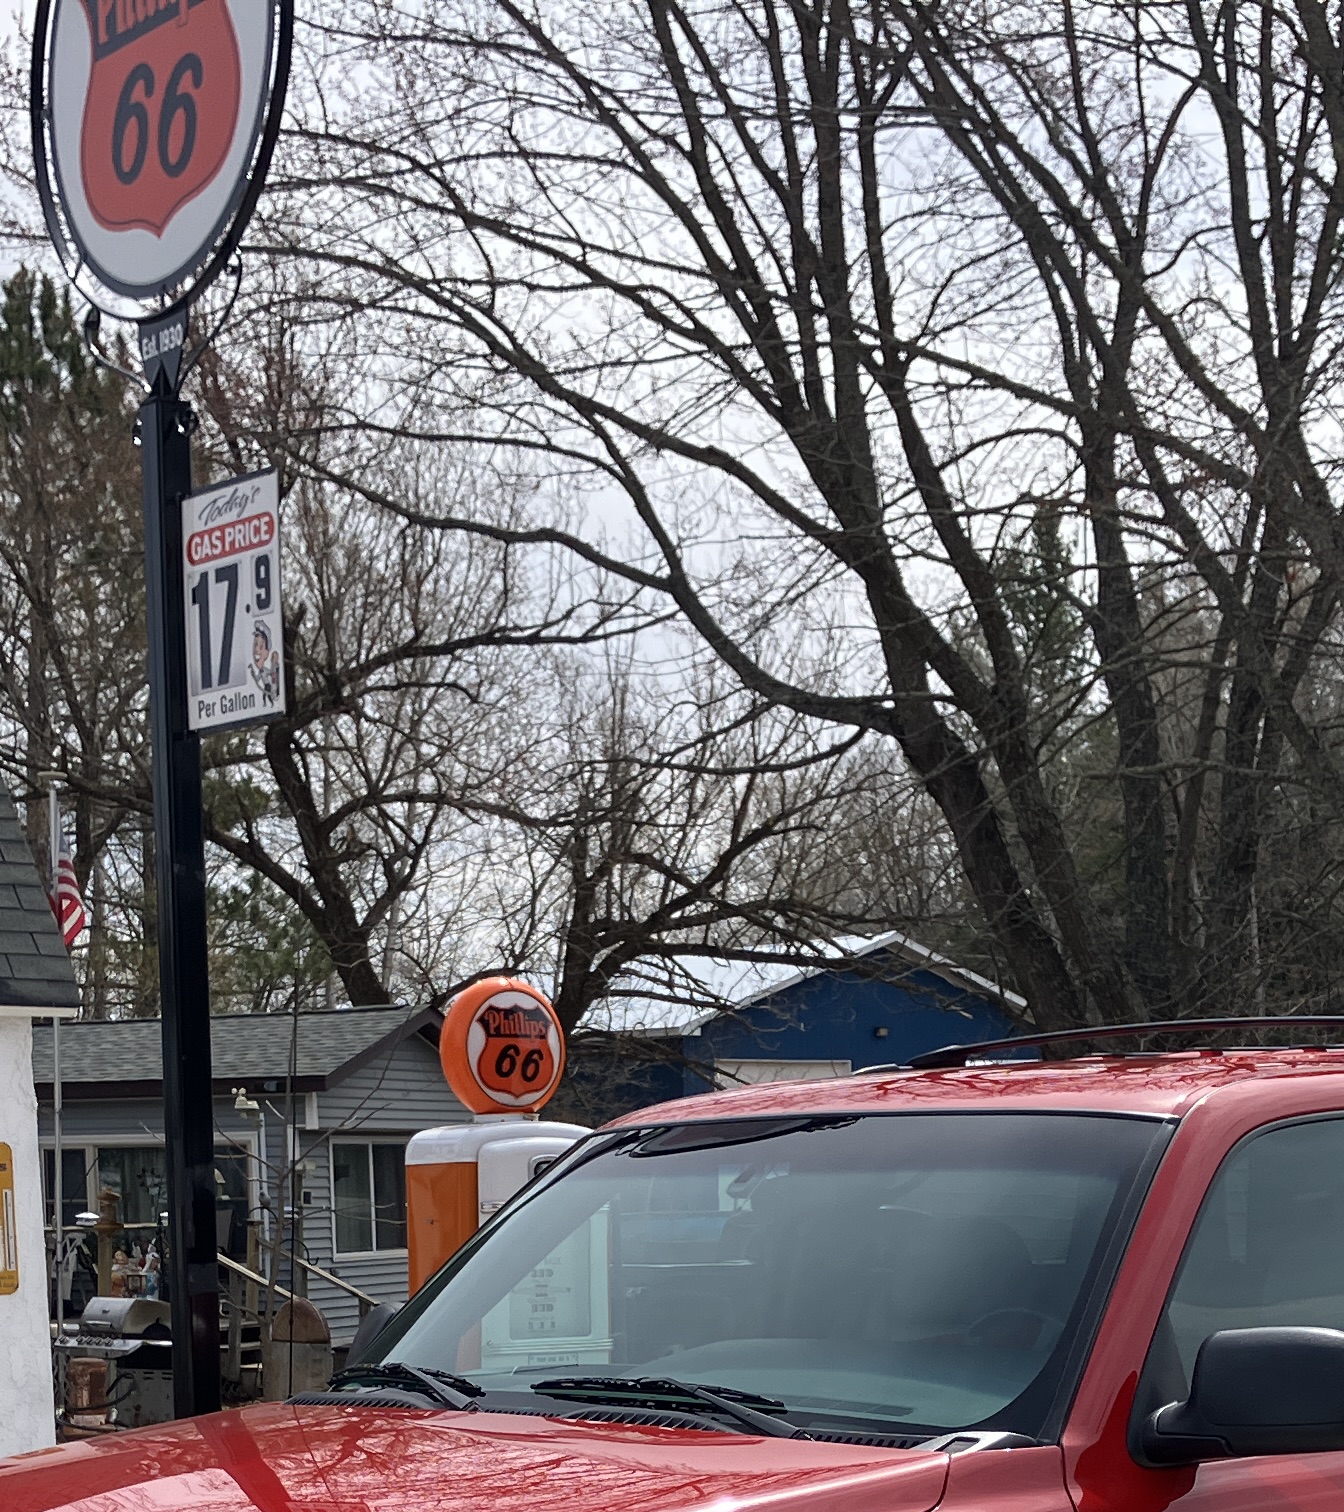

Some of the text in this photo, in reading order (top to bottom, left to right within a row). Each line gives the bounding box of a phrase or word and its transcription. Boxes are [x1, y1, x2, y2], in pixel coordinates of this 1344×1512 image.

[112, 52, 203, 185] 66
[198, 485, 260, 527] Today's
[191, 516, 270, 560] GAS PRICE
[198, 692, 255, 719] Per Gallon
[485, 1010, 546, 1041] Phillips
[495, 1044, 544, 1082] 66
